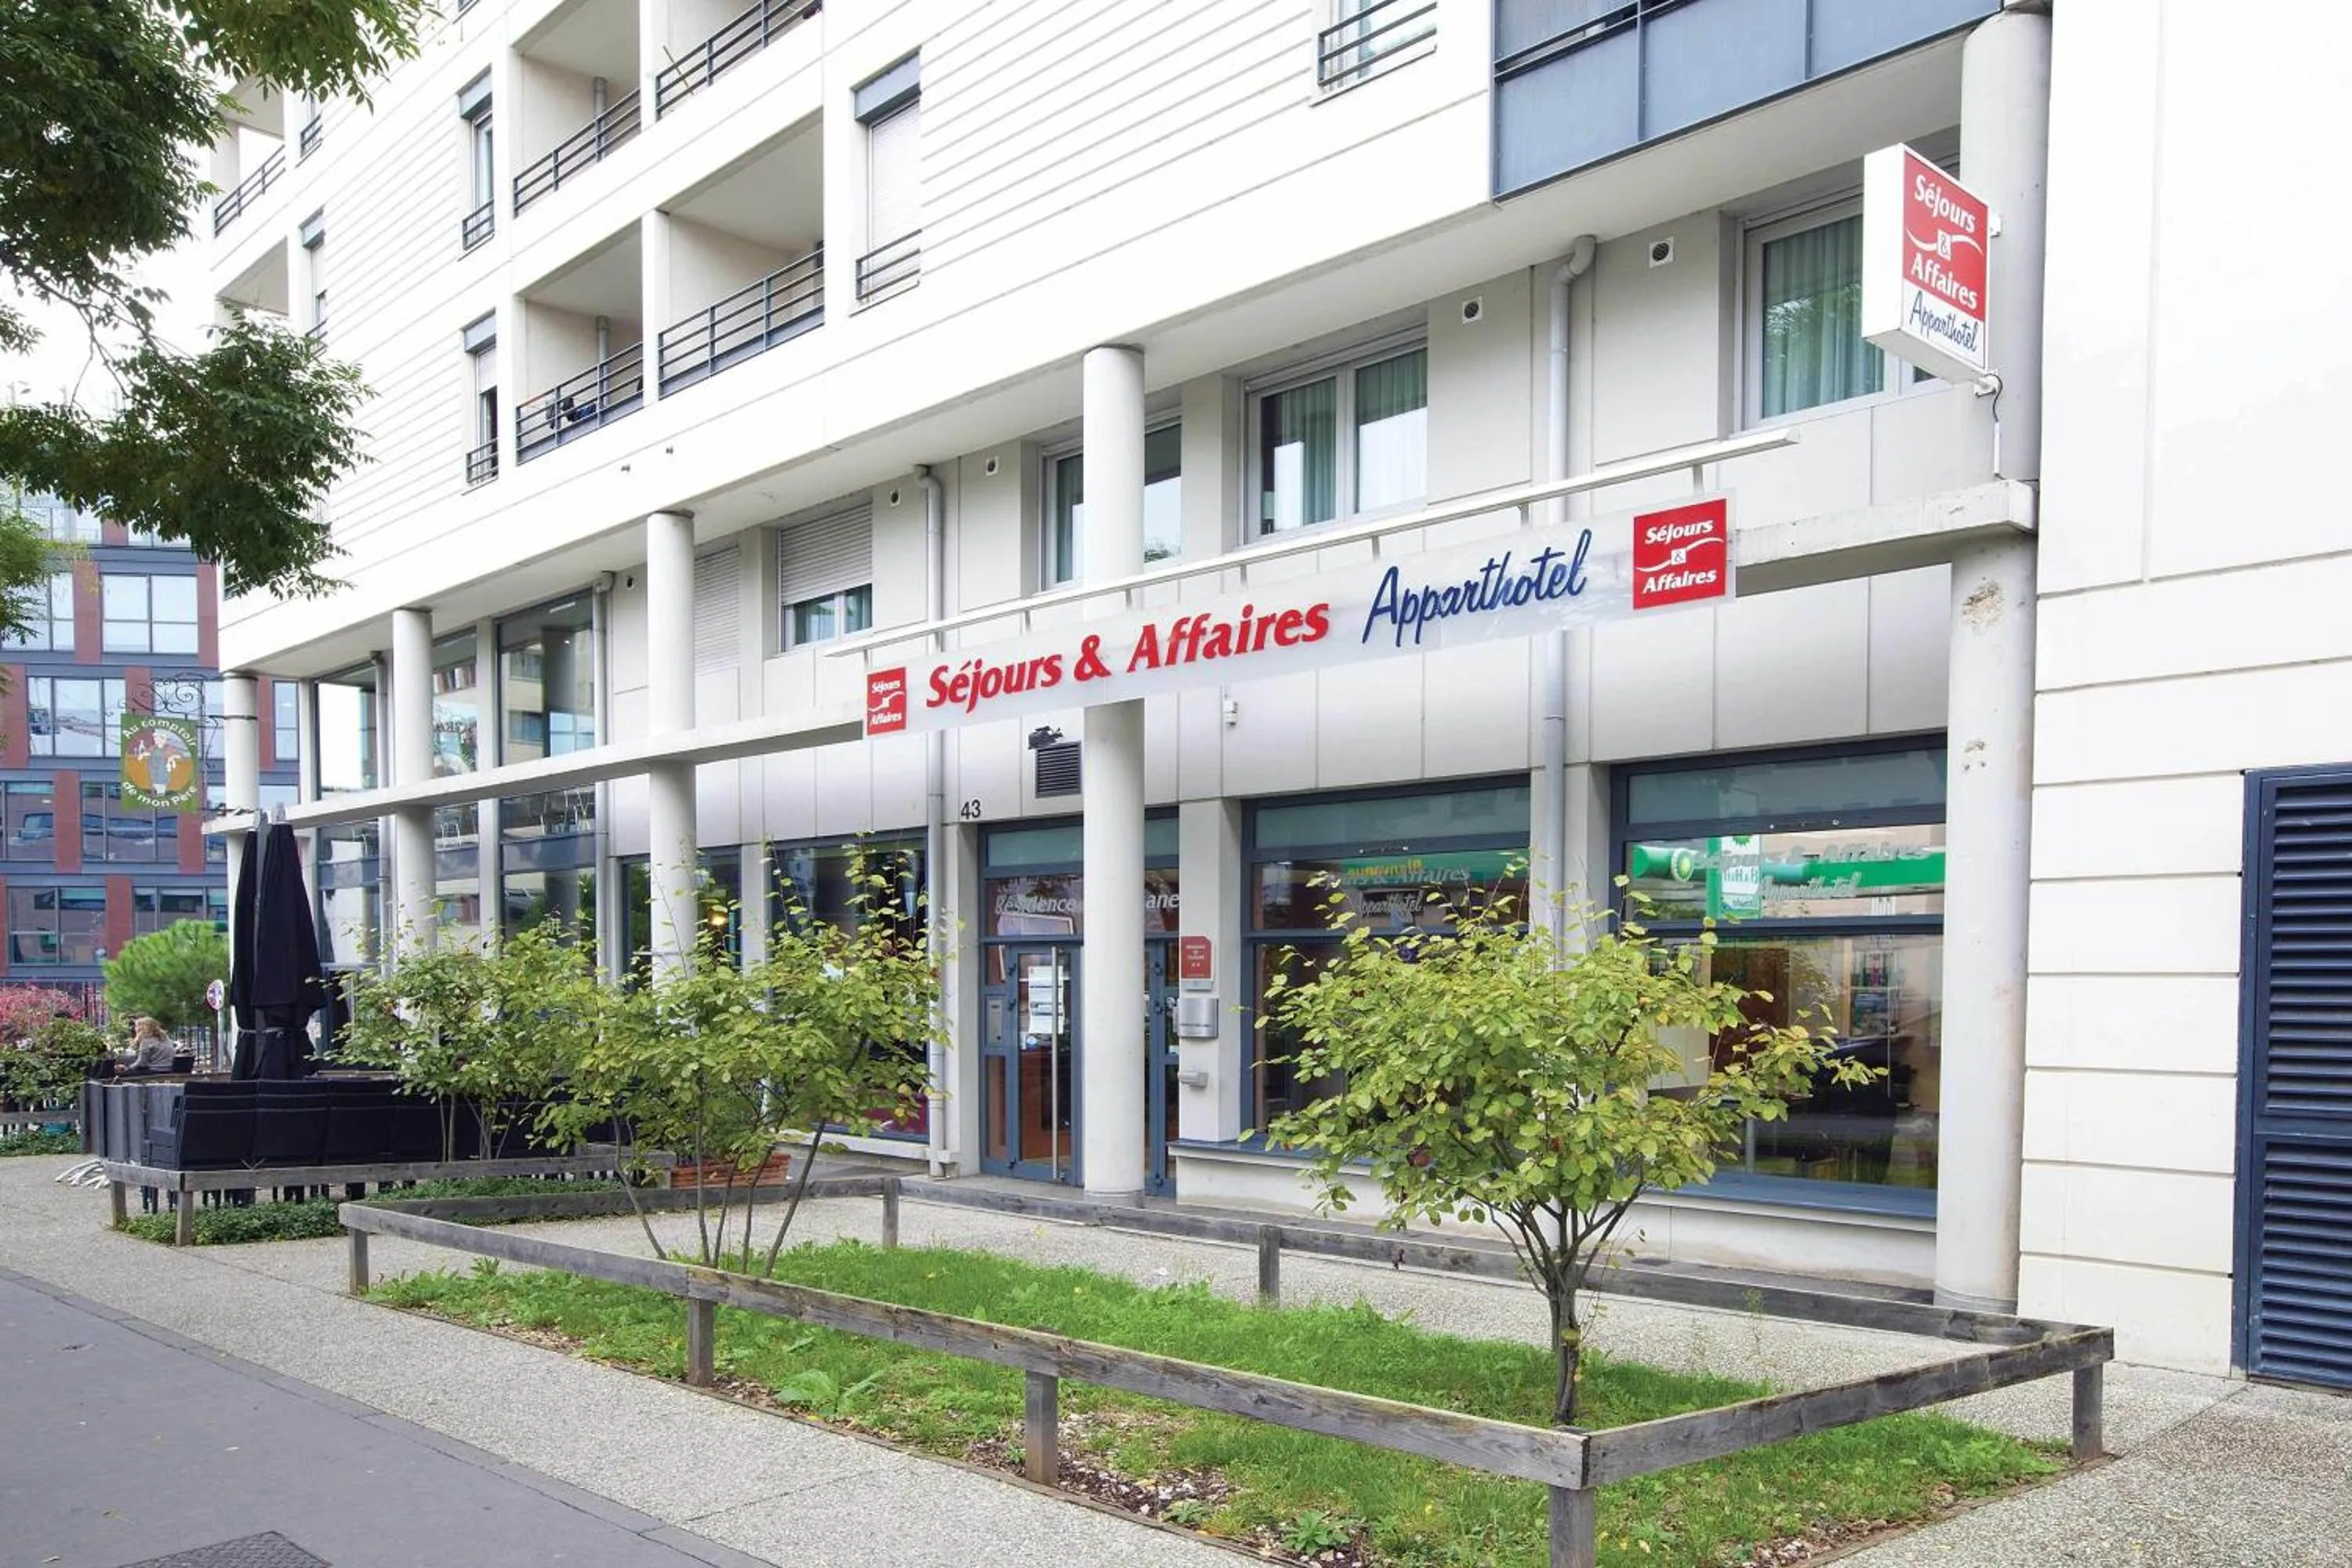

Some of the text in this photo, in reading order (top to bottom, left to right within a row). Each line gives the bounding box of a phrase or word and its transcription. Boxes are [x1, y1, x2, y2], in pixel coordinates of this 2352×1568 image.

[1914, 174, 1976, 233] Séjours
[1940, 234, 1949, 253] &
[1911, 252, 1977, 310] Affaires
[1909, 290, 1977, 352] Apparthotel
[1645, 519, 1714, 544] Séjours
[1673, 550, 1685, 563] &
[1642, 569, 1717, 594] Affaires
[926, 528, 1592, 713] Séjours & Affaires Apparthotel
[122, 719, 198, 746] Au comptoir
[122, 781, 137, 796] de
[137, 794, 170, 807] mon
[961, 799, 981, 820] 43
